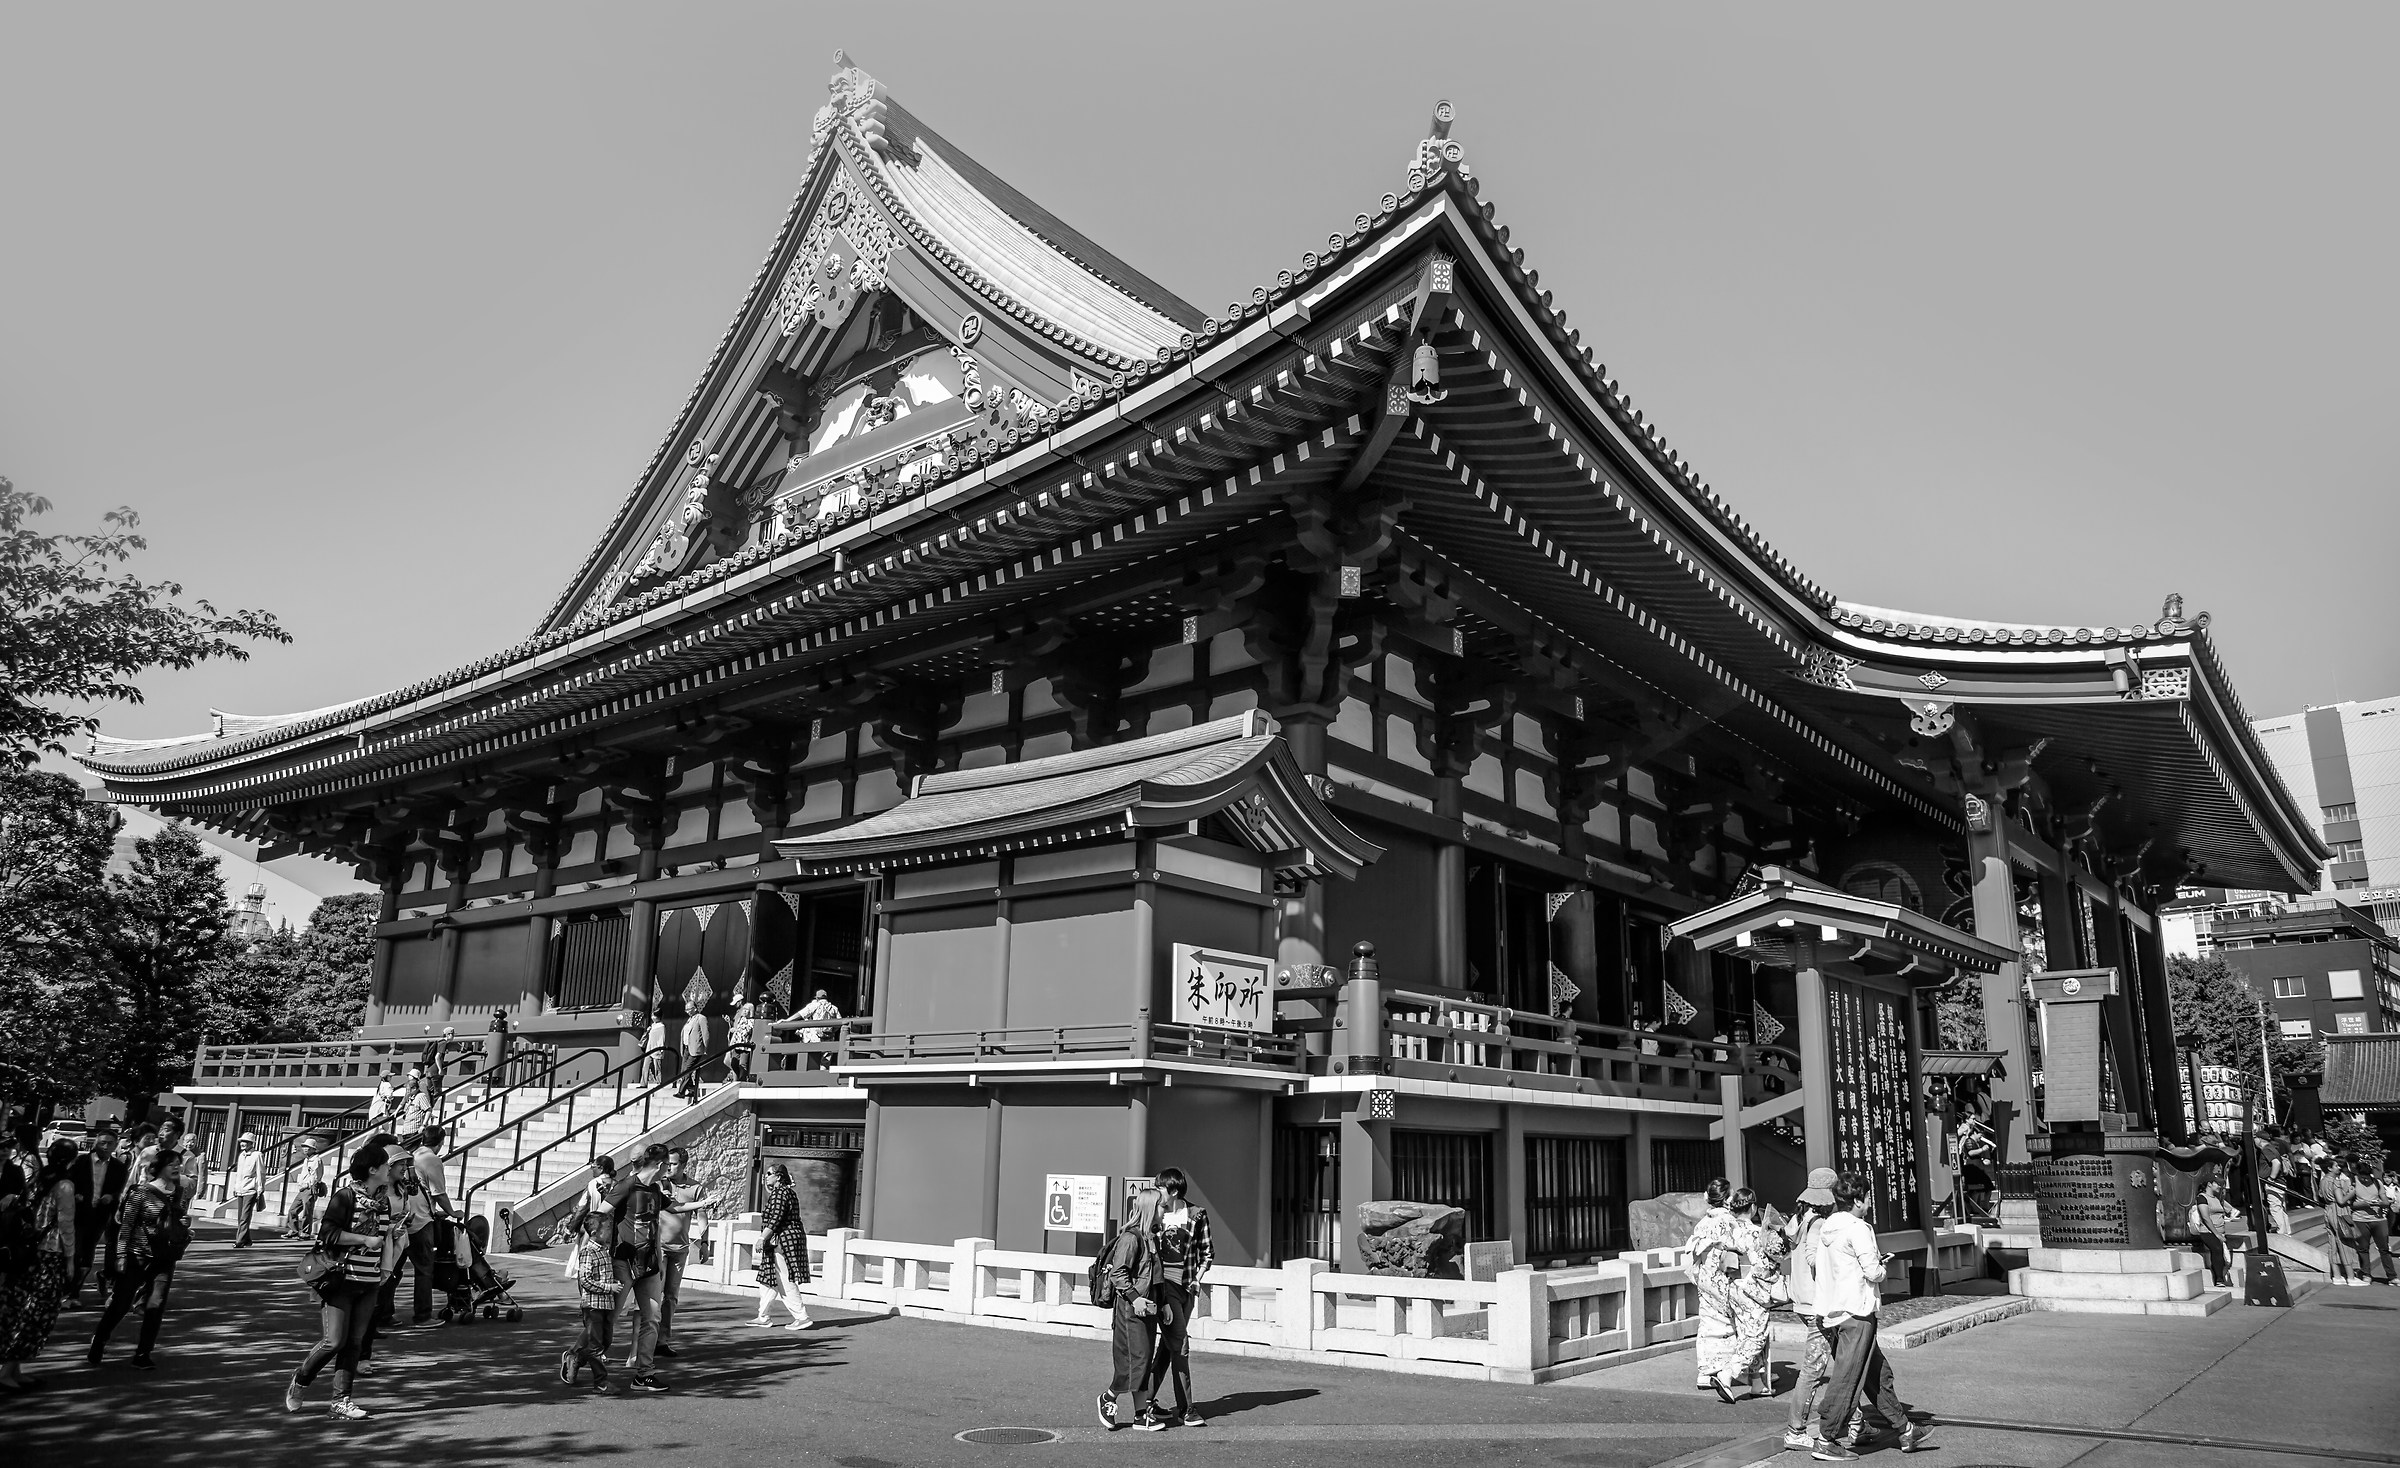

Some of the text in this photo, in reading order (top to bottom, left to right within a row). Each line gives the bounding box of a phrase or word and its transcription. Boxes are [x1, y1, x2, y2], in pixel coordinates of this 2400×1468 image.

[2175, 889, 2206, 899] EUM
[2359, 888, 2400, 902] 区立台
[1187, 967, 1264, 1019] 朱印所
[1866, 1034, 1885, 1167] 連月法要
[1896, 1018, 1917, 1193] 本堂連日法会
